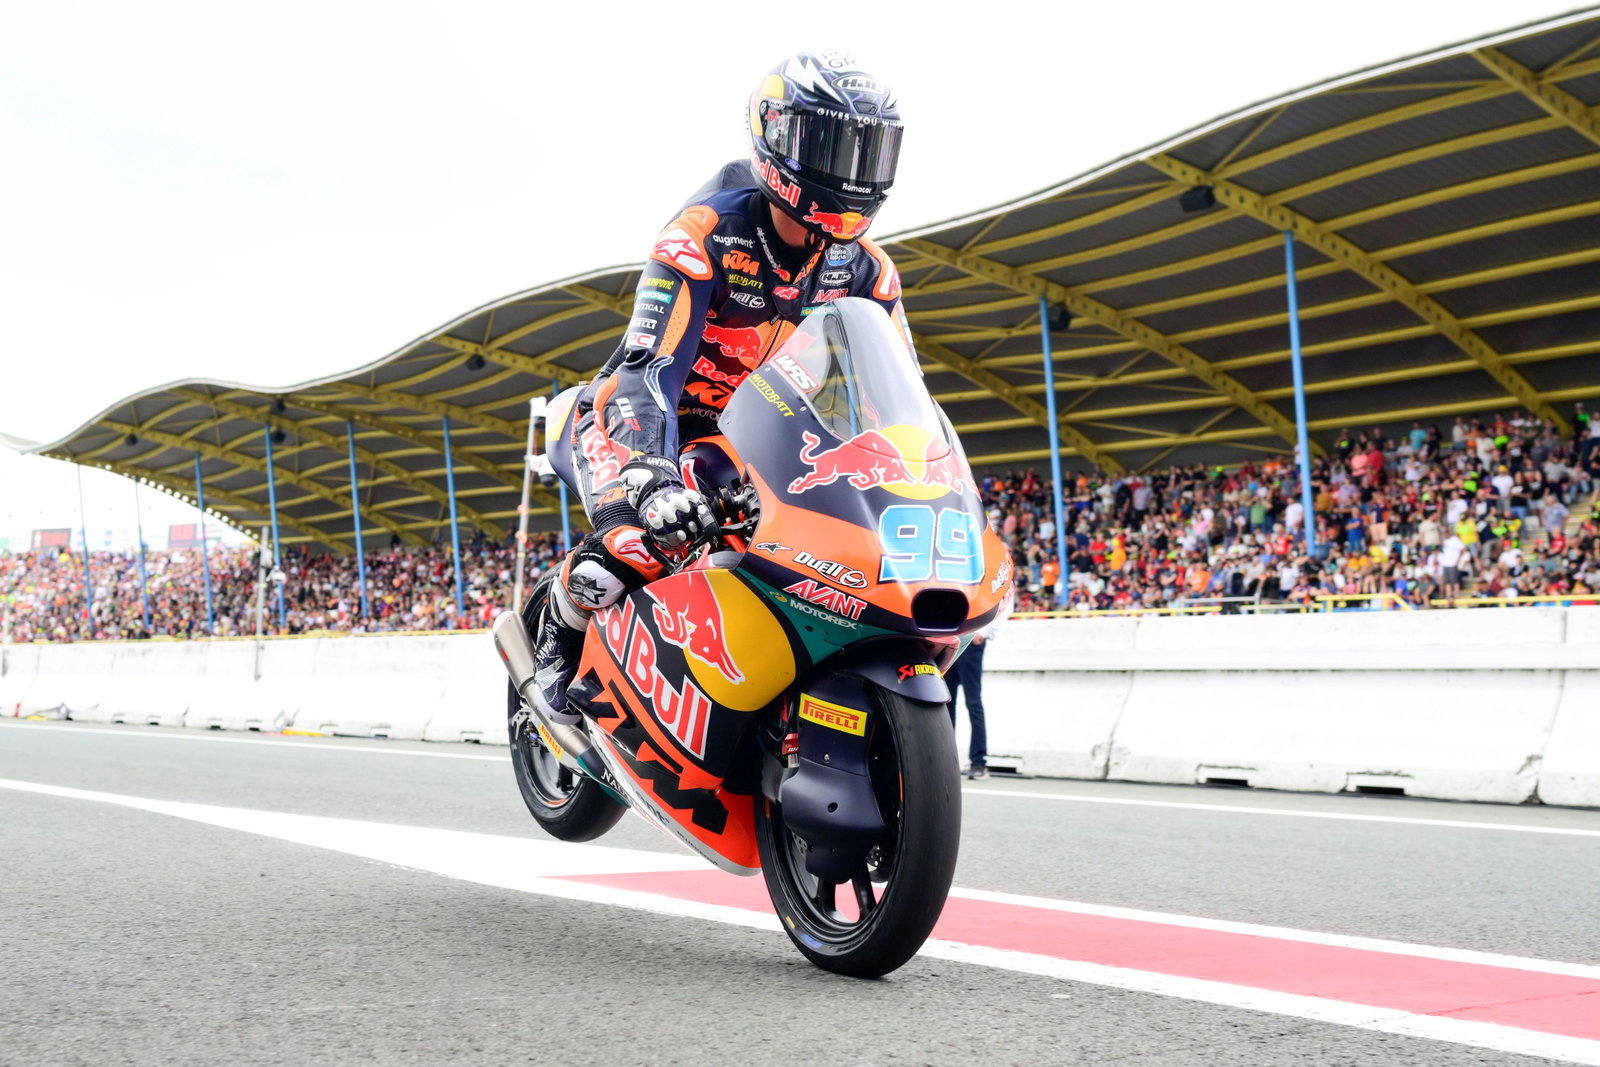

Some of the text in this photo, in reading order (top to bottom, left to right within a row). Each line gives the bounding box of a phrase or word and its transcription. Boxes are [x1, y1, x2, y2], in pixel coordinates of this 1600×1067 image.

[816, 107, 850, 121] GIVES
[856, 115, 878, 126] YOU
[752, 150, 770, 182] ed
[767, 164, 801, 208] Bull
[842, 182, 873, 194] Romacar
[712, 234, 754, 249] augment
[722, 250, 760, 276] KTM
[822, 272, 849, 282] HJC
[691, 355, 751, 389] Red
[747, 373, 795, 417] MOTOBATT
[877, 505, 985, 585] 99
[782, 578, 868, 620] AVANT
[789, 599, 857, 630] MOTOREX
[625, 613, 713, 762] Bull
[803, 699, 860, 731] PIRELLI
